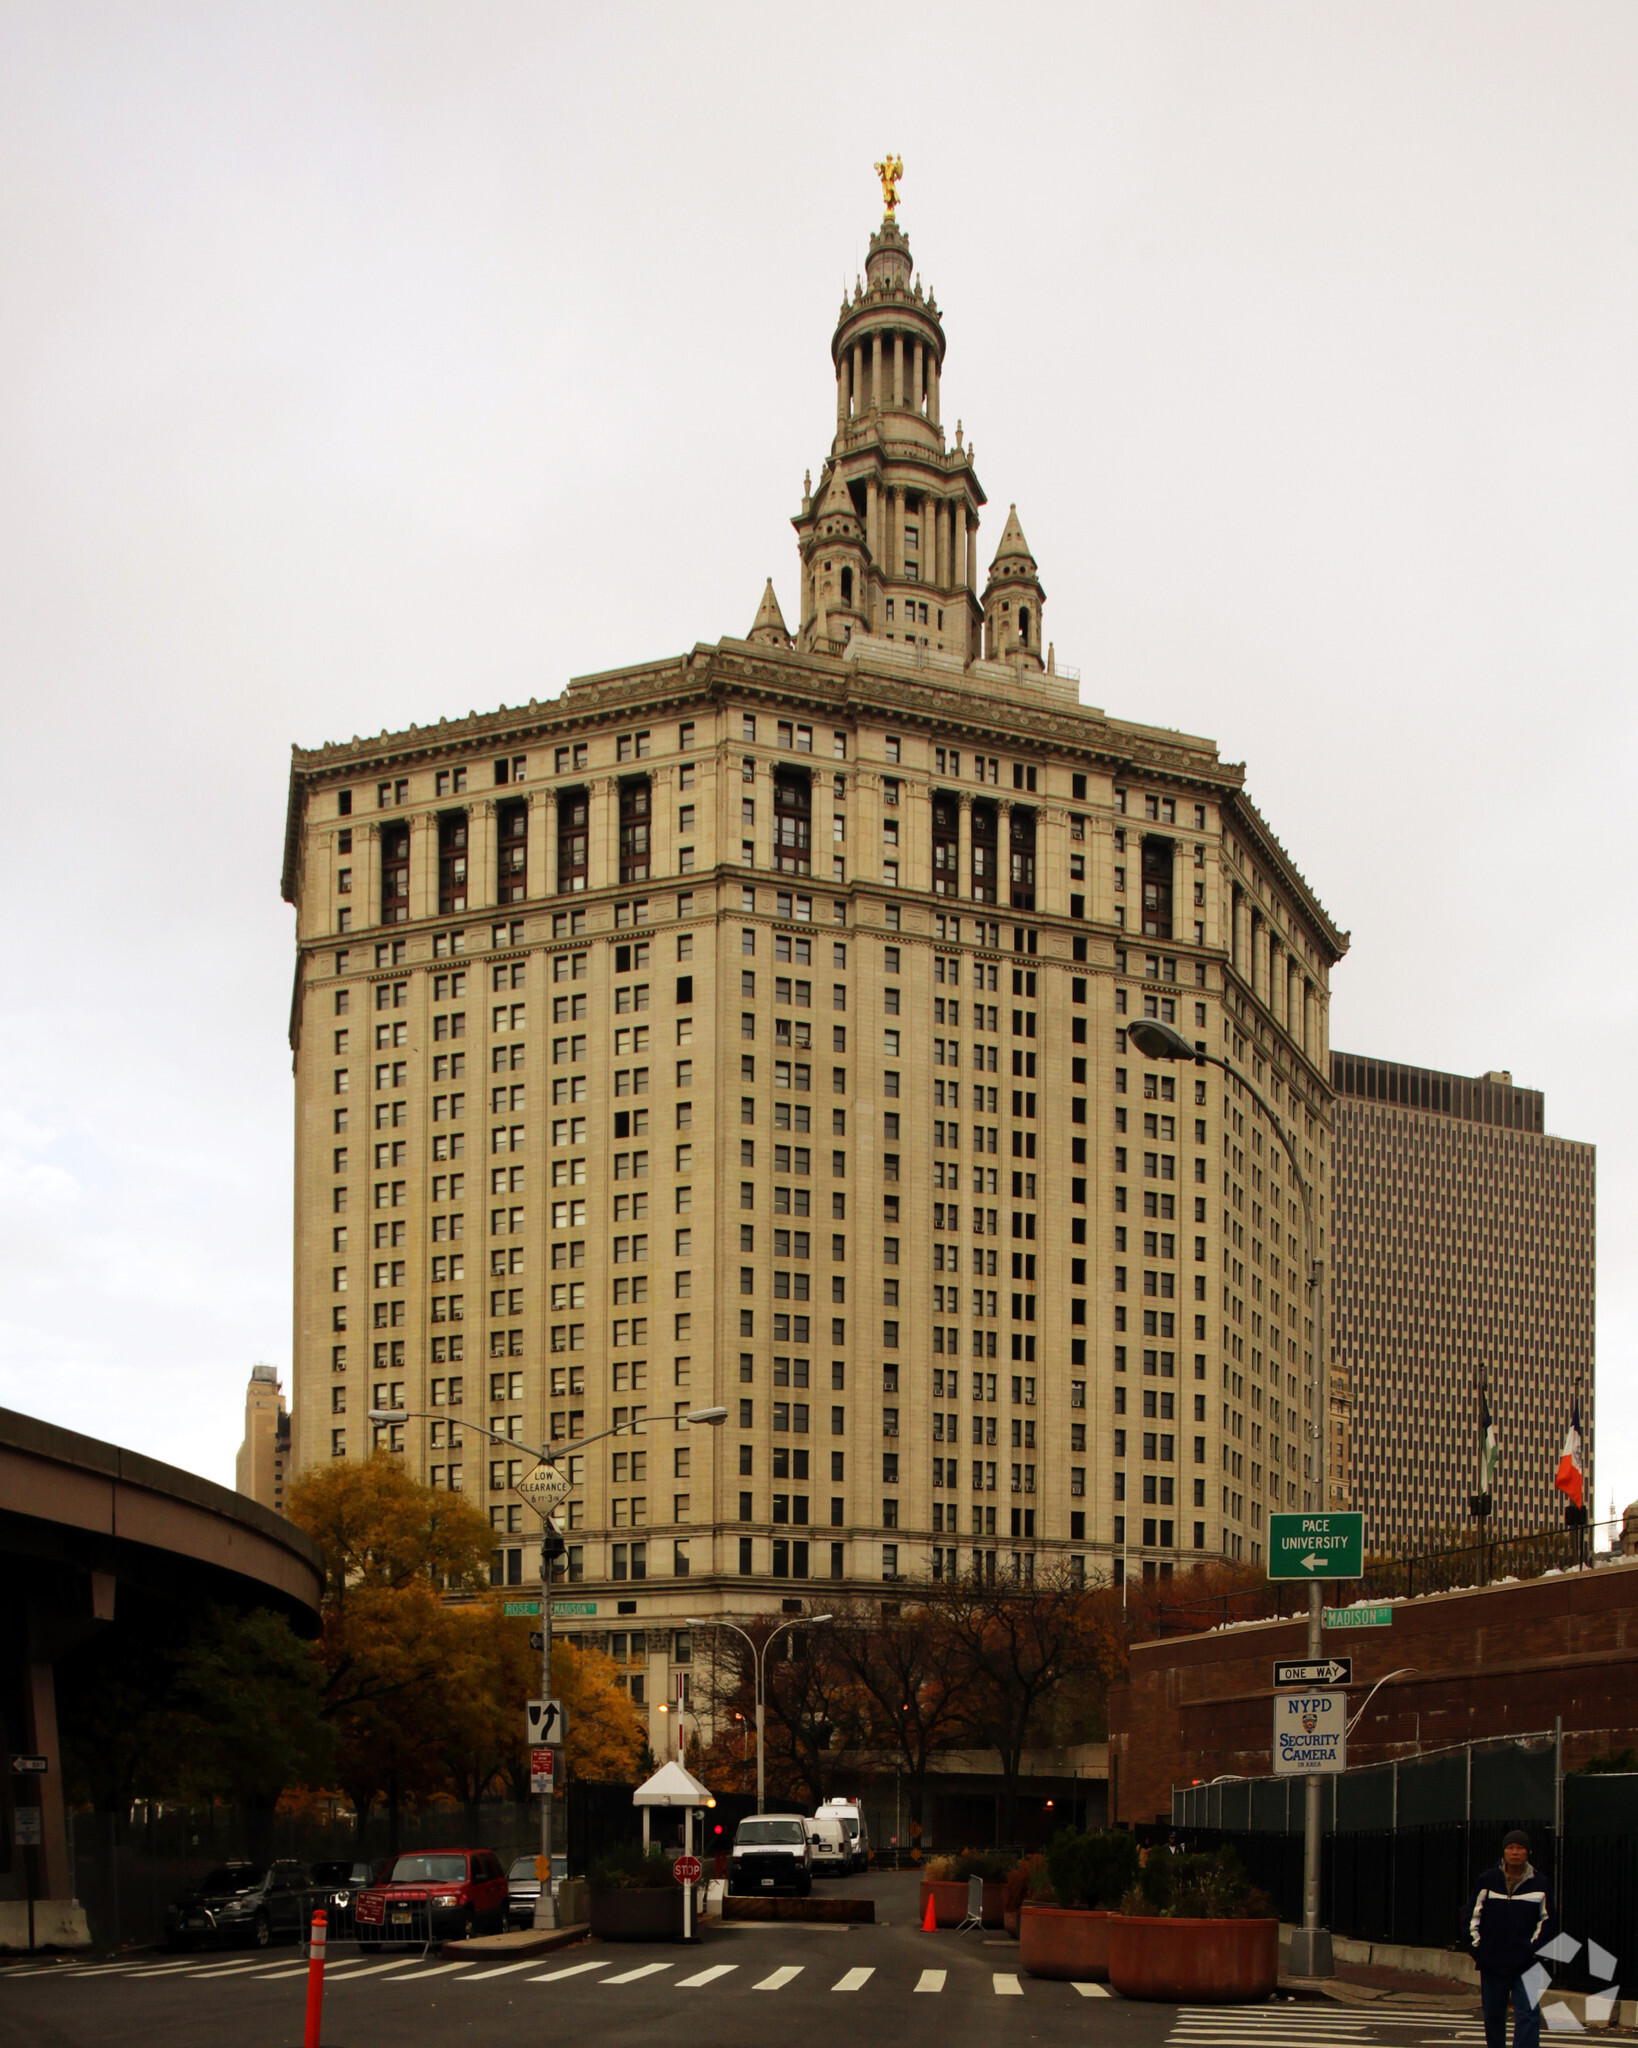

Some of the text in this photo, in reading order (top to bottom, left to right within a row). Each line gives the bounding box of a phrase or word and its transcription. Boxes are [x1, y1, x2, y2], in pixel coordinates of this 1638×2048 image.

[535, 1472, 553, 1481] LOW
[521, 1483, 567, 1492] CLEARANCE
[1302, 1519, 1330, 1532] PACE
[1281, 1536, 1349, 1550] UNIVERSITY
[506, 1603, 530, 1615] ROSE
[554, 1603, 587, 1615] MADISON
[1328, 1608, 1388, 1626] MADISON ST
[1285, 1666, 1339, 1679] ONE WAY
[1288, 1698, 1332, 1714] NYPD
[1279, 1733, 1340, 1747] SECURITY
[1282, 1747, 1337, 1761] CAMERA
[675, 1864, 700, 1876] STOP
